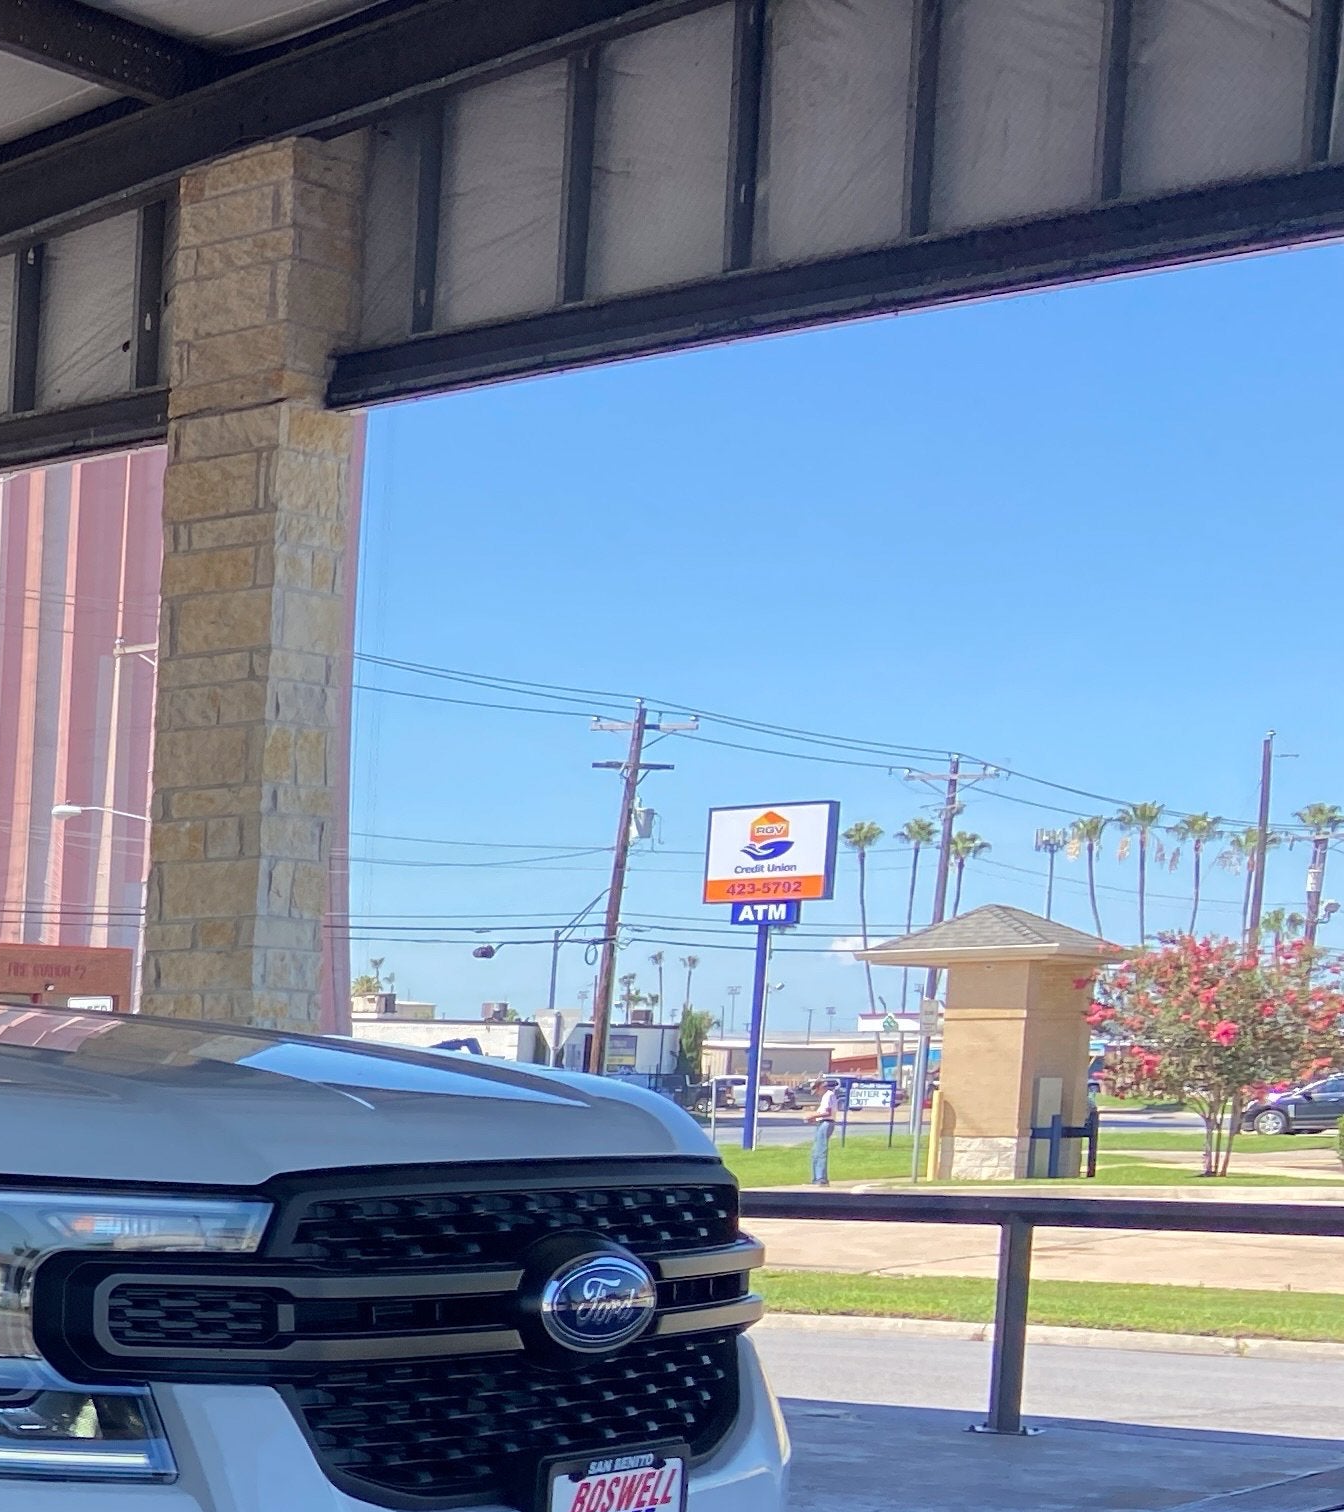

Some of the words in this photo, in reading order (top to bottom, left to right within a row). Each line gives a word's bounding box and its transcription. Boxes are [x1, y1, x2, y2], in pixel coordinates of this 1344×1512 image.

[756, 825, 784, 834] RGV
[734, 864, 765, 875] Credit
[767, 862, 797, 873] Union
[738, 903, 787, 922] ATM
[851, 1090, 880, 1098] ENTER
[576, 1277, 636, 1327] Ford
[588, 1459, 612, 1475] SAN
[614, 1453, 654, 1471] BENITO
